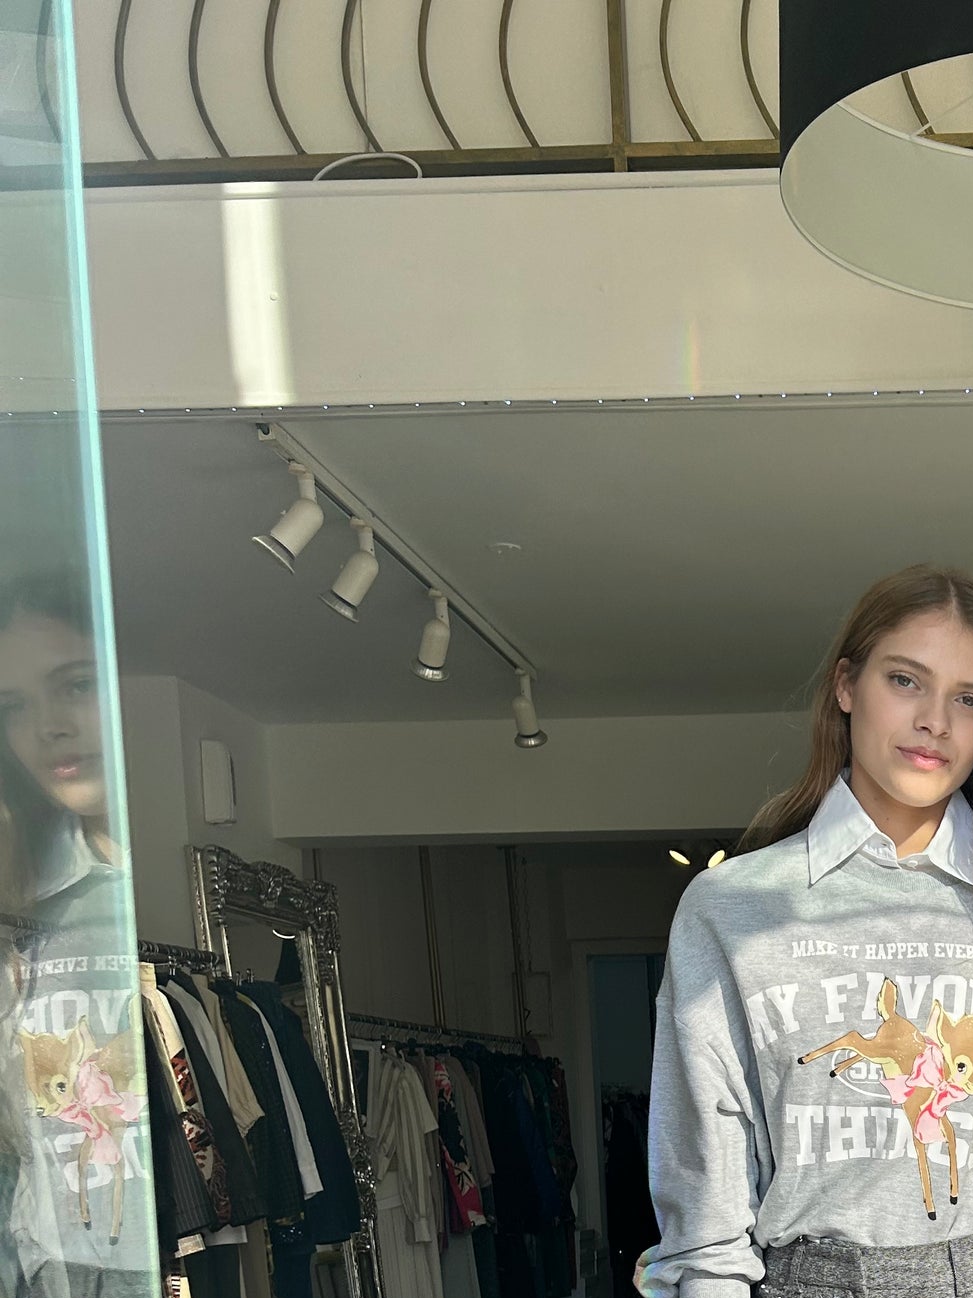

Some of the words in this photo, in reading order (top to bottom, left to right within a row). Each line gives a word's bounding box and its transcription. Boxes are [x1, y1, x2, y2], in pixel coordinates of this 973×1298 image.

[792, 940, 838, 958] MAKE
[842, 944, 859, 959] IT
[865, 942, 929, 960] HAPPEN
